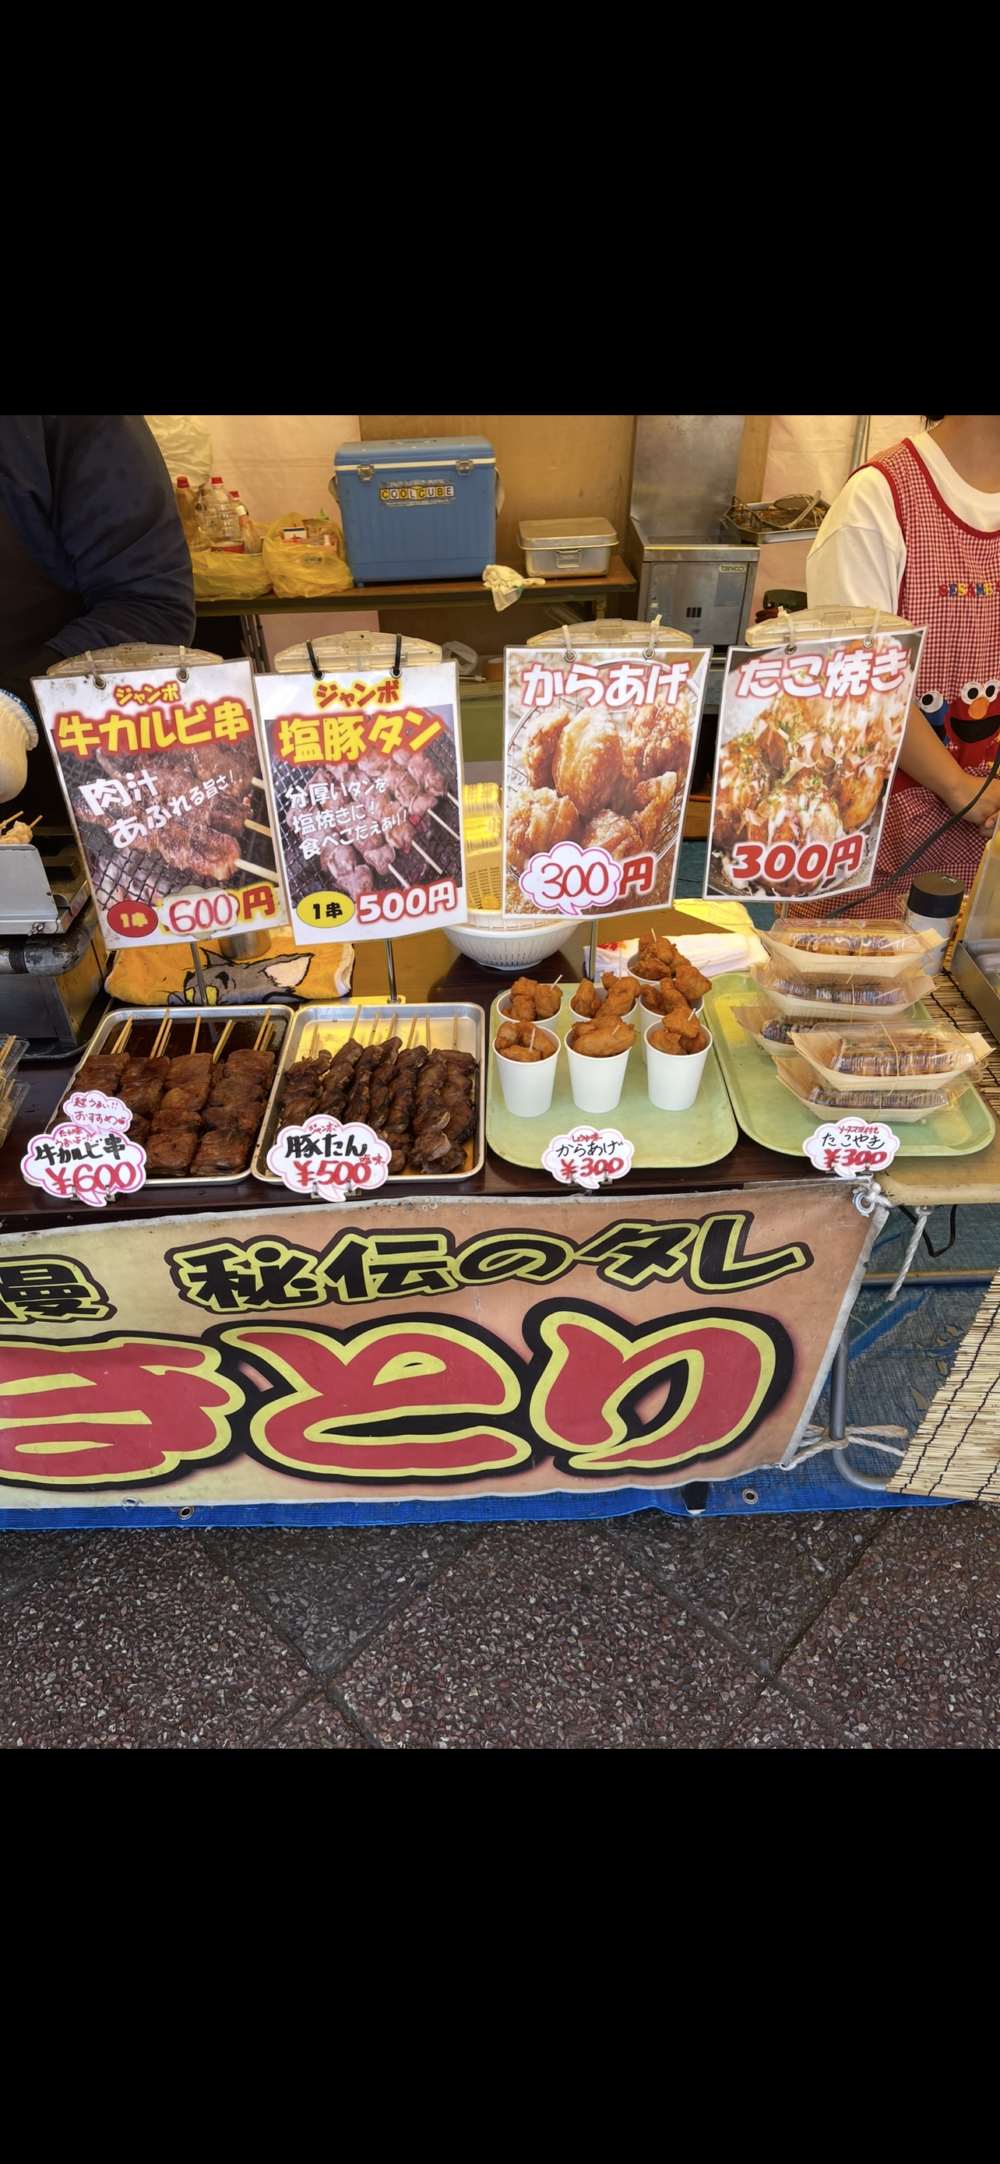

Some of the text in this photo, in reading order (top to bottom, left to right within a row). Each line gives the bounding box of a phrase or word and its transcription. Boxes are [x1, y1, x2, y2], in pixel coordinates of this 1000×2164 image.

[939, 582, 994, 597] SESAME
[522, 661, 690, 707] からあげ
[737, 648, 909, 698] たこ焼き
[115, 682, 181, 706] ジャンボ
[316, 680, 400, 709] ジャンボ
[57, 700, 250, 756] 牛カルビ串
[278, 710, 442, 764] 塩豚タン
[79, 769, 159, 816] 肉汁
[285, 777, 388, 809] 分厚いタンを
[732, 834, 863, 880] 300円
[541, 855, 654, 900] 300円
[169, 885, 276, 933] 600円
[312, 880, 456, 923] 1串 500円
[285, 1133, 368, 1159] 豚たん
[556, 1140, 624, 1158] からあげ
[822, 1132, 885, 1150] たこやき
[823, 1148, 888, 1168] ¥300
[45, 1161, 137, 1195] ¥600
[293, 1160, 372, 1187] ¥500
[560, 1157, 624, 1181] ¥300
[172, 1213, 807, 1313] 秘伝のタレ
